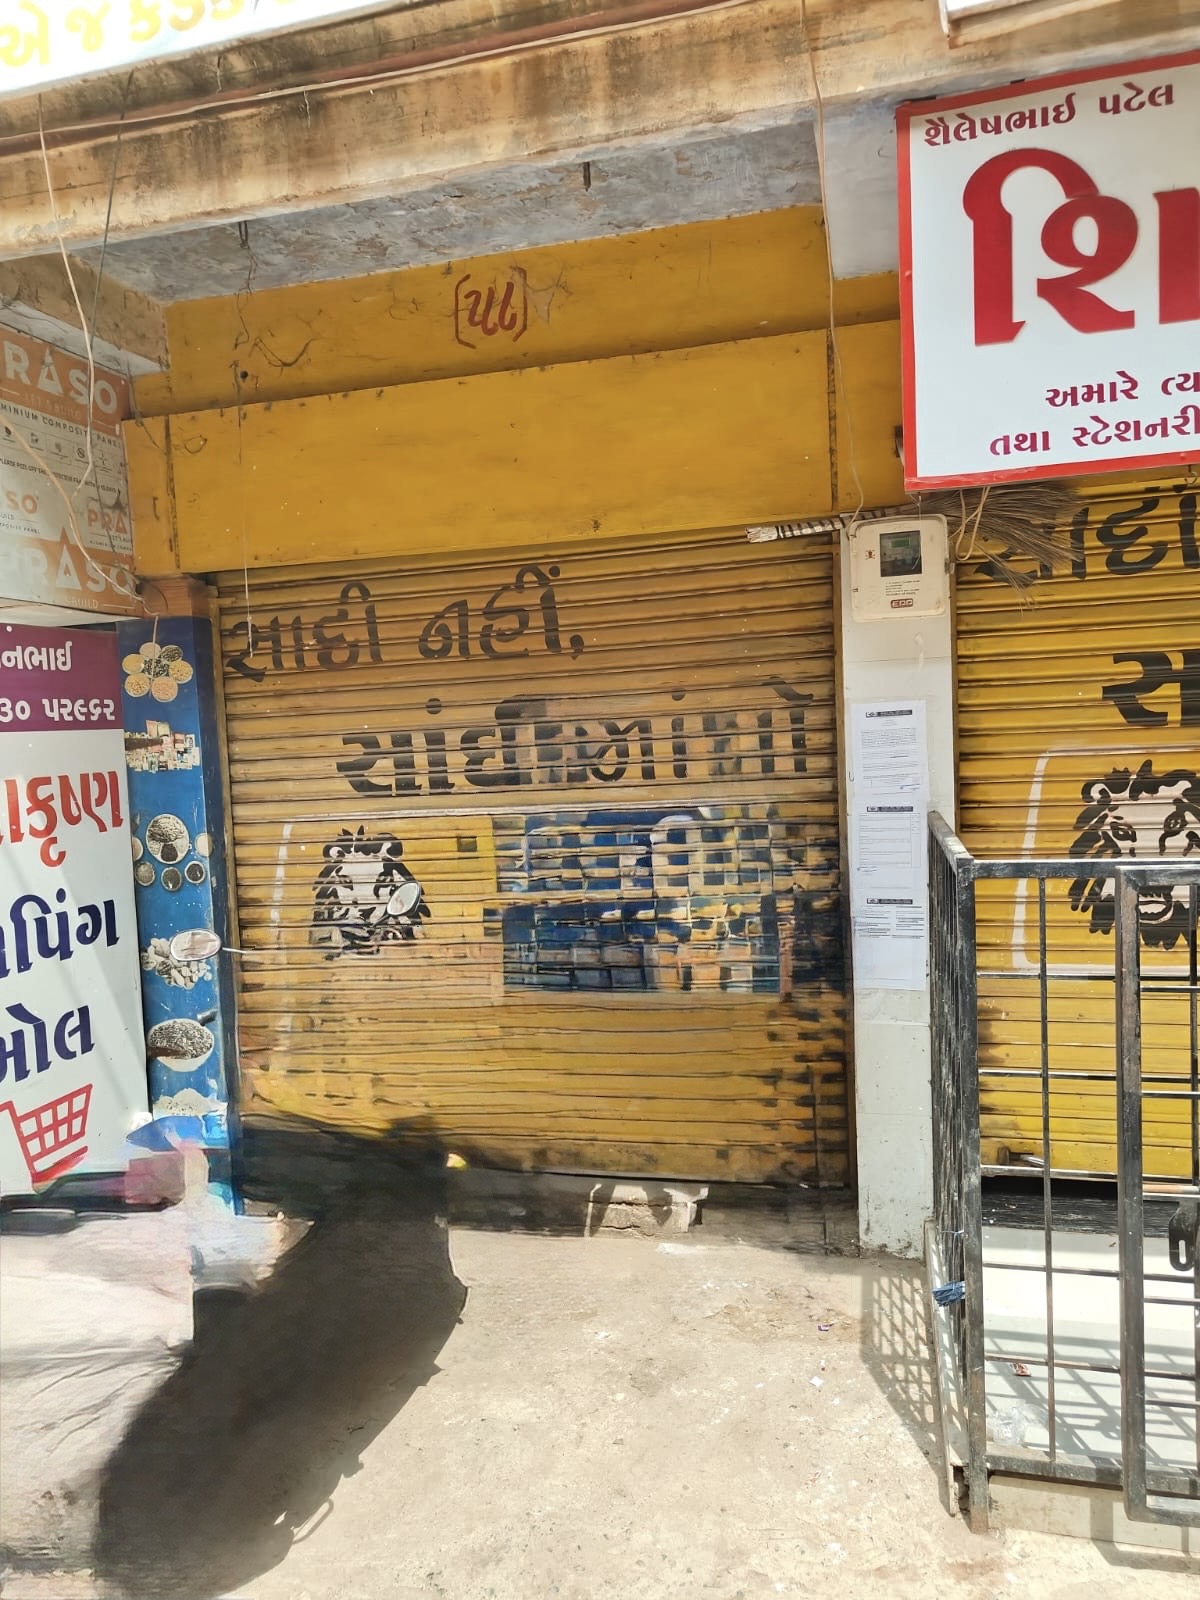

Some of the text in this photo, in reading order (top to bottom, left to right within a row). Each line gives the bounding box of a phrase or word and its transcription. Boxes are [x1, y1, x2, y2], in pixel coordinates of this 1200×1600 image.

[924, 81, 1175, 147] શૈલેષભાઈ પટેલ
[1045, 370, 1139, 408] અમારે
[42, 416, 92, 438] COMPOSIT
[989, 404, 1200, 456] તથા સ્ટેશનરી
[0, 640, 73, 671] નભાઈ
[0, 770, 124, 868] ાકૃષ્ણ
[0, 887, 120, 980] પિંગ
